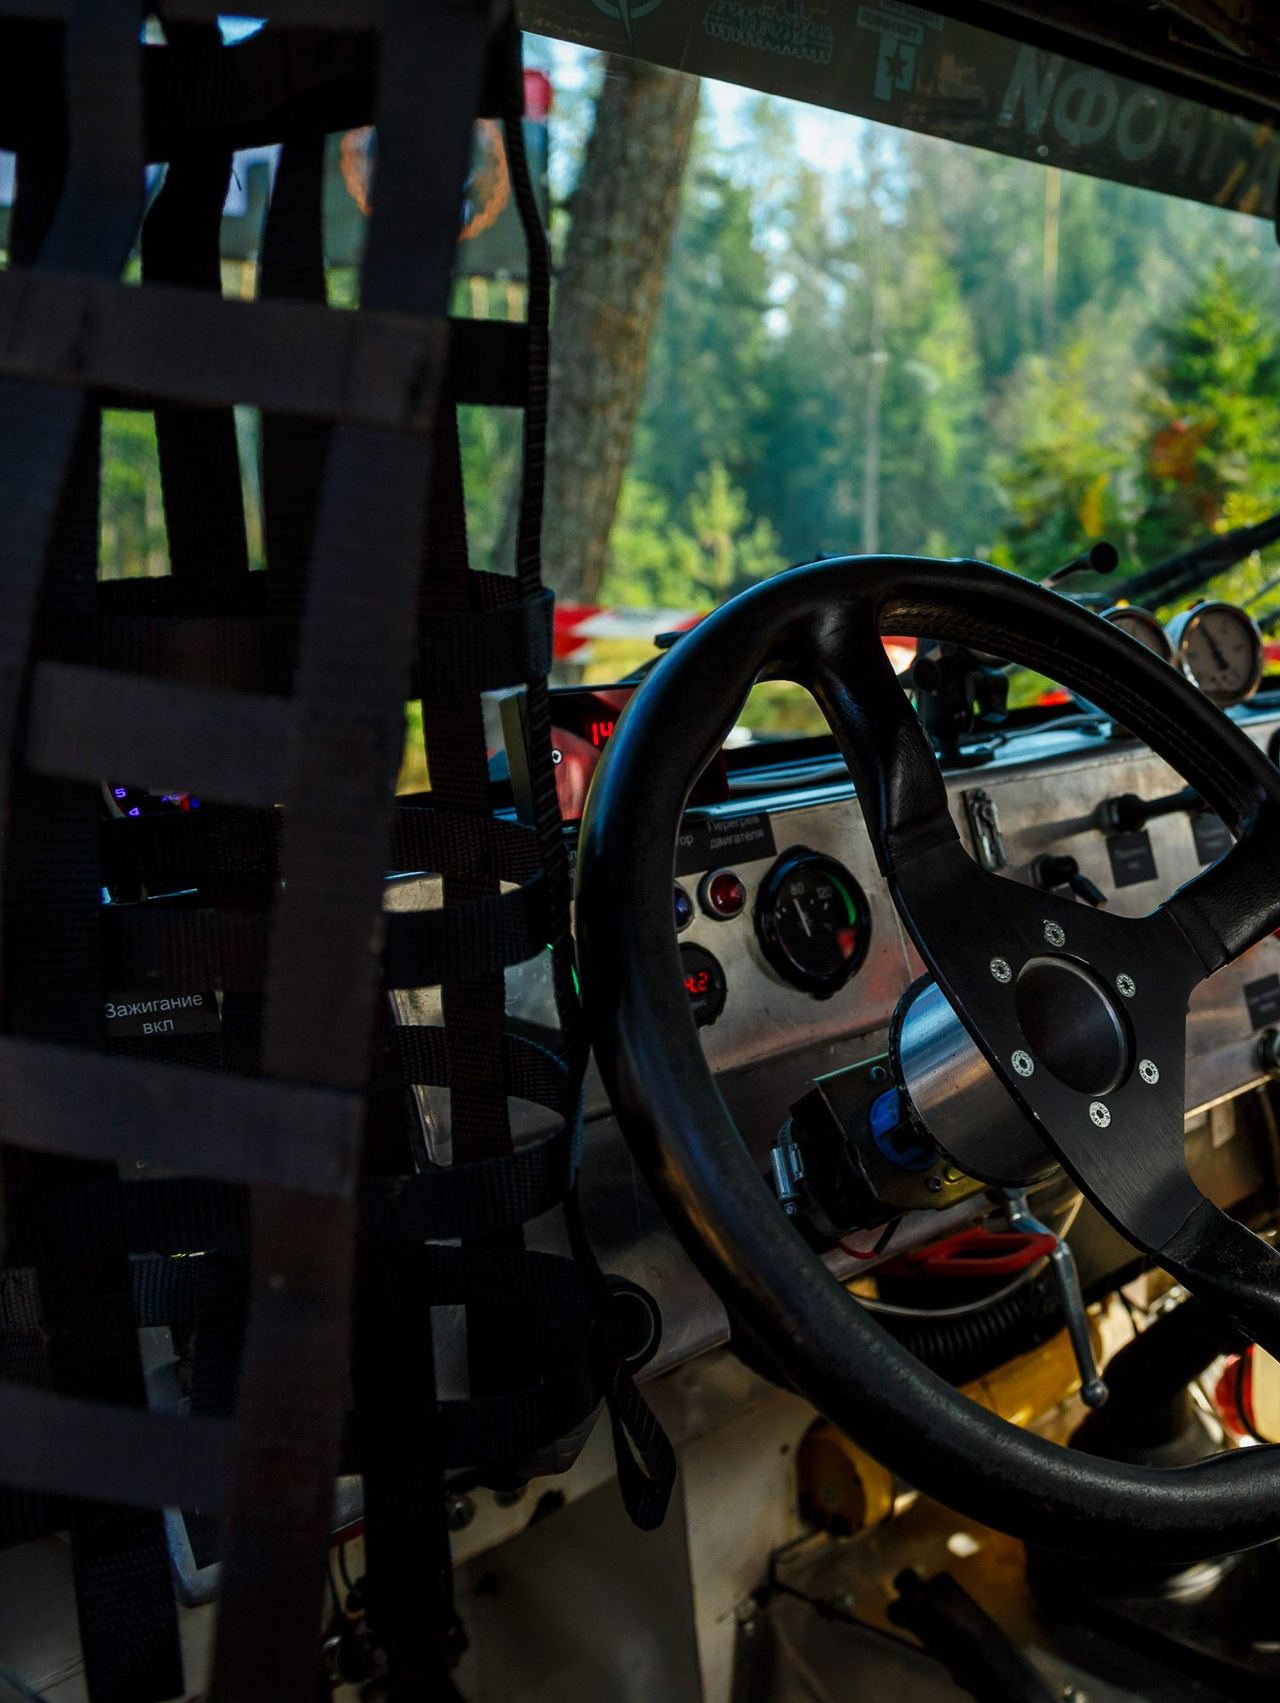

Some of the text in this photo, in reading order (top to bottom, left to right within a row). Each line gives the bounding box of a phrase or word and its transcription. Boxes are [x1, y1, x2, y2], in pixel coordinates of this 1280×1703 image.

[114, 787, 127, 799] 5
[709, 829, 765, 851] двигателя
[816, 885, 834, 900] 120
[104, 994, 204, 1019] Зажигание
[142, 1019, 175, 1035] вкл
